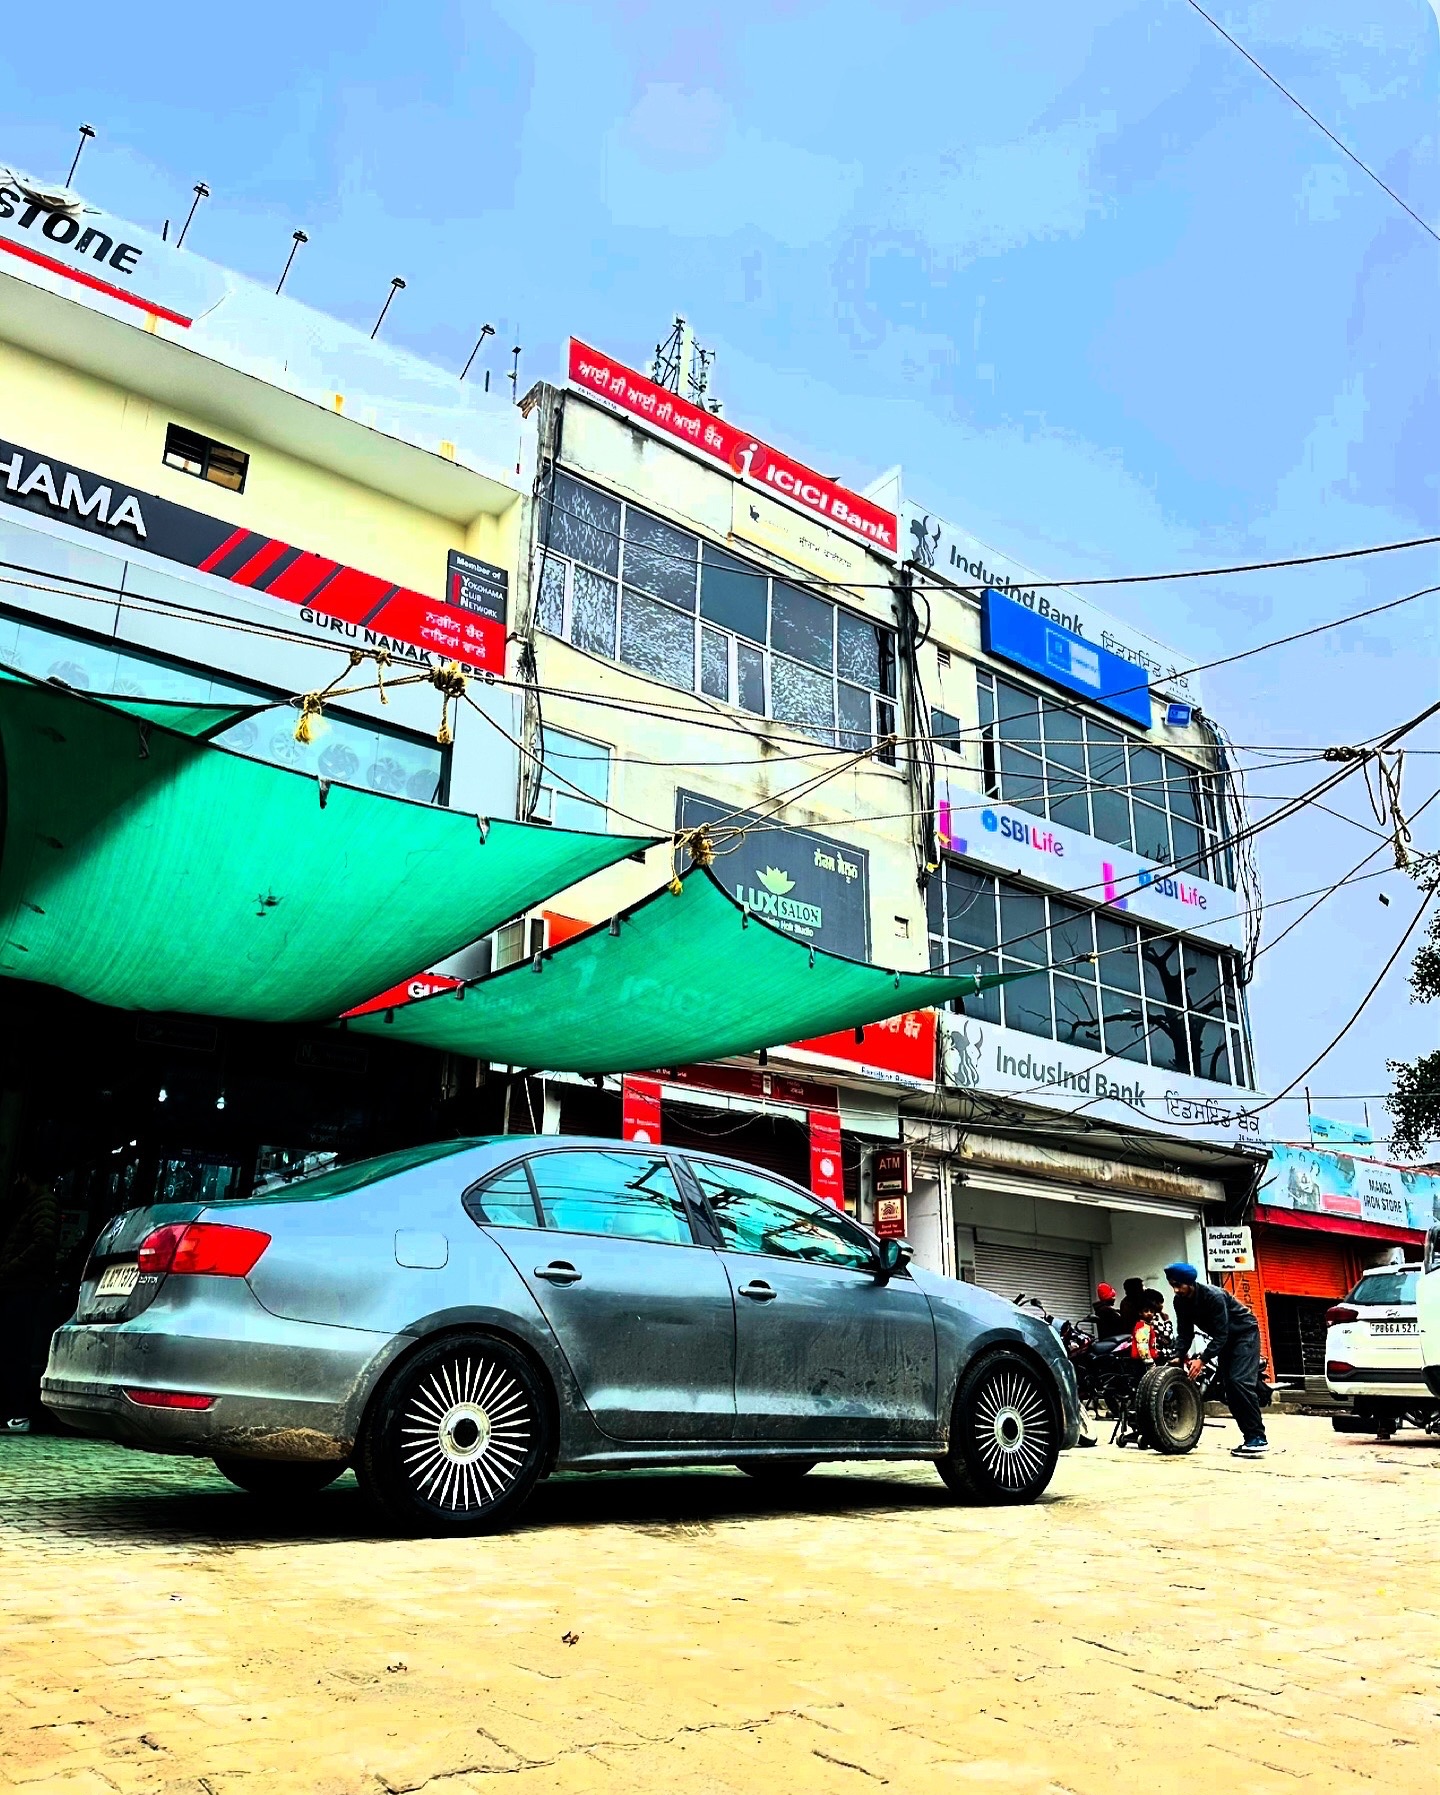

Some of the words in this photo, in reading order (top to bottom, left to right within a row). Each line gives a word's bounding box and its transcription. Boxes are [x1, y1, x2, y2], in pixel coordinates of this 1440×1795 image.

[578, 361, 610, 388] ਆਈ
[609, 376, 627, 396] ਸੀ
[627, 387, 657, 414] ਆਈ
[656, 402, 673, 422] ਸੀ
[673, 413, 701, 438] ਆਈ
[766, 464, 830, 511] ICICI
[830, 499, 891, 545] Bank
[456, 556, 490, 576] Member
[491, 571, 501, 580] of
[949, 544, 1036, 610] IndusInd
[1038, 597, 1084, 637] Bank
[300, 608, 357, 638] GURU
[363, 628, 432, 667] NANAK
[1000, 815, 1030, 845] SBI
[1032, 826, 1064, 857] Life
[736, 884, 778, 917] LUX
[781, 900, 819, 923] SALON
[1154, 874, 1179, 900] SBI
[1180, 882, 1207, 910] Life
[996, 1045, 1091, 1094] IndusInd
[1095, 1073, 1146, 1108] Bank
[879, 1156, 900, 1170] ATM
[1380, 1197, 1403, 1214] STORE
[1208, 1231, 1243, 1240] IndusInd
[1218, 1247, 1230, 1255] hrs
